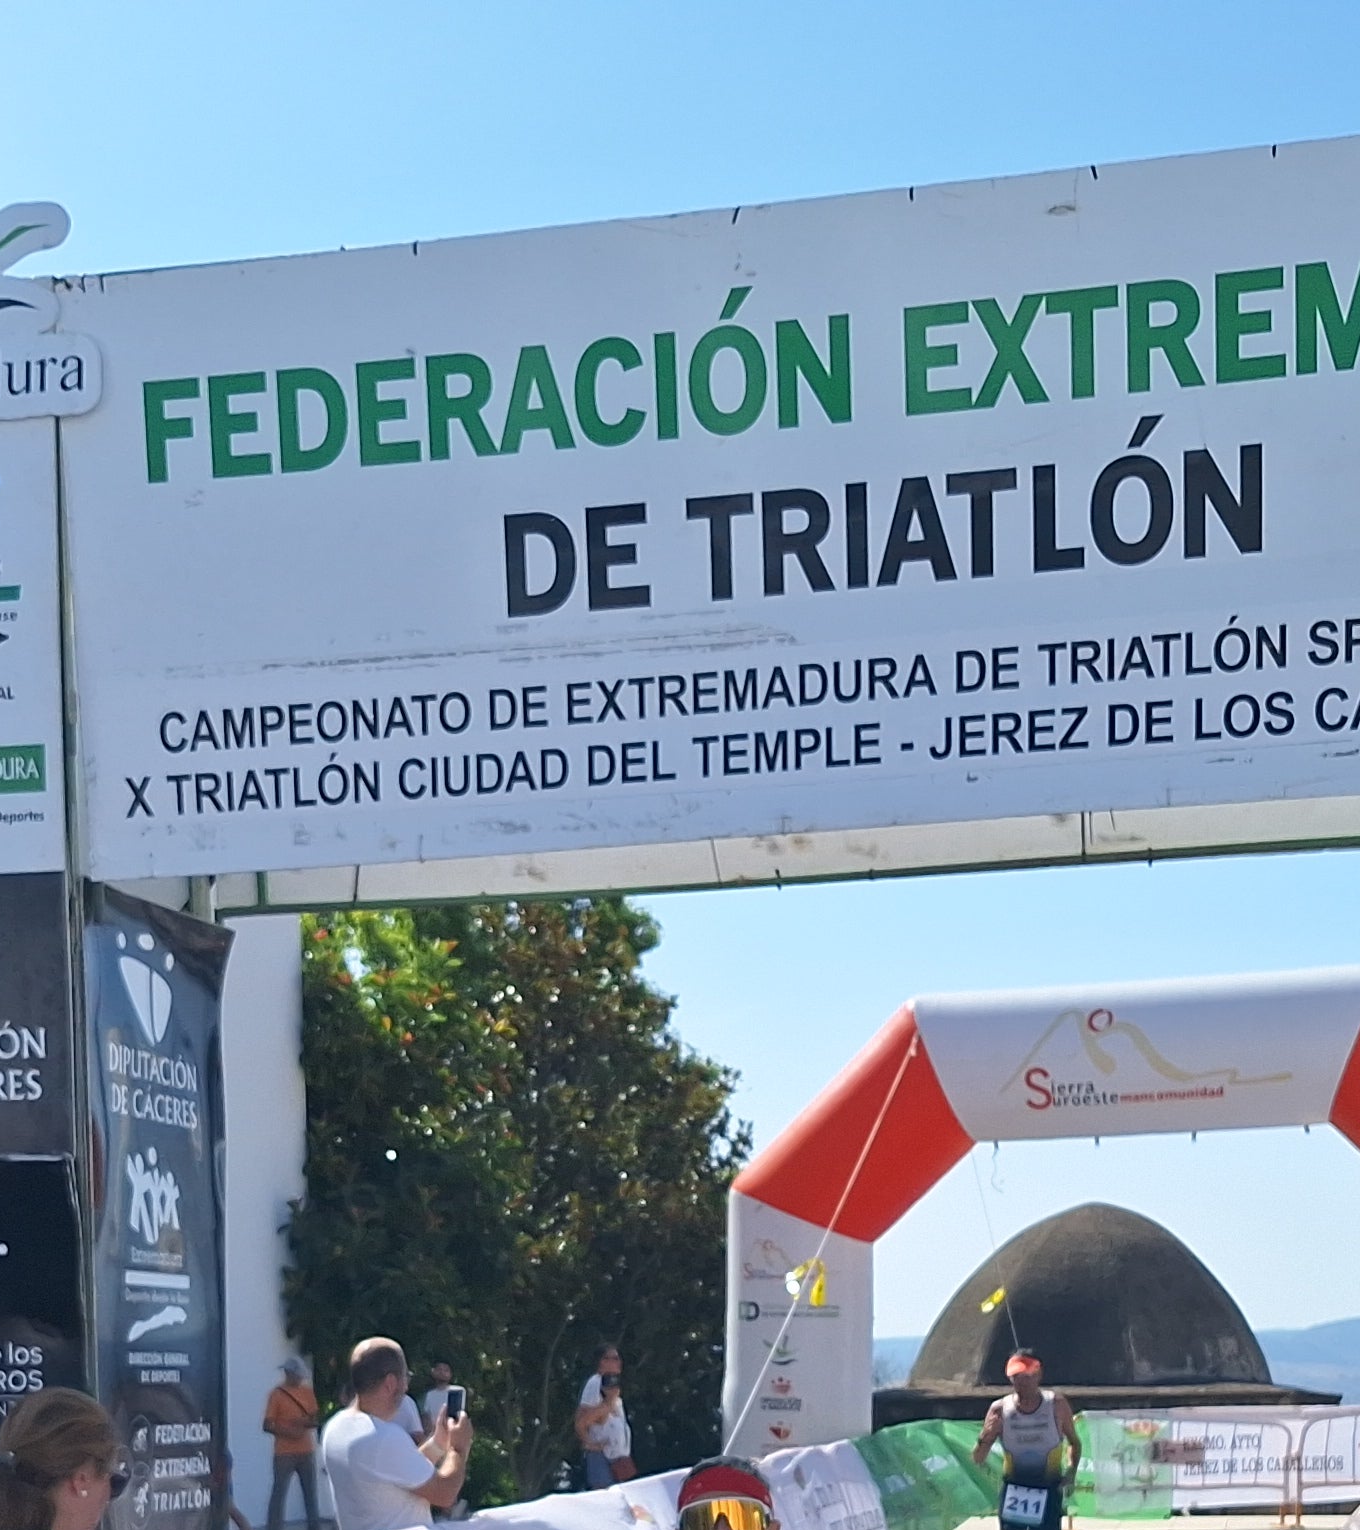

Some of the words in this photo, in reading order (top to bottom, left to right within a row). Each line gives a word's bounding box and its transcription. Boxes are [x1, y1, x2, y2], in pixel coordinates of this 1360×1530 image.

[142, 285, 853, 484] FEDERACIÓN
[503, 502, 652, 618] DE
[685, 414, 1264, 602] TRIATLÓN
[159, 691, 472, 754] CAMPEONATO
[488, 685, 549, 732] DE
[565, 653, 938, 726] EXTREMADURA
[955, 646, 1021, 695] DE
[1038, 615, 1288, 686] TRIATLÓN
[125, 777, 156, 819] X
[167, 751, 382, 816] TRIATLÓN
[397, 747, 570, 801] CIUDAD
[587, 740, 678, 787] DEL
[691, 723, 883, 778] TEMPLE
[928, 706, 1090, 761] JEREZ
[1107, 700, 1175, 747] DE
[1194, 691, 1296, 742] LOS
[107, 1041, 198, 1094] DIPUTACIÓN
[109, 1085, 129, 1116] DE
[131, 1086, 198, 1131] CÁCERES
[7, 1341, 44, 1366] los
[155, 1416, 211, 1444] FEDERACIÓN
[154, 1451, 211, 1478] EXTREMEÑA
[153, 1488, 211, 1512] TRIATLÓN
[1006, 1496, 1041, 1514] 211
